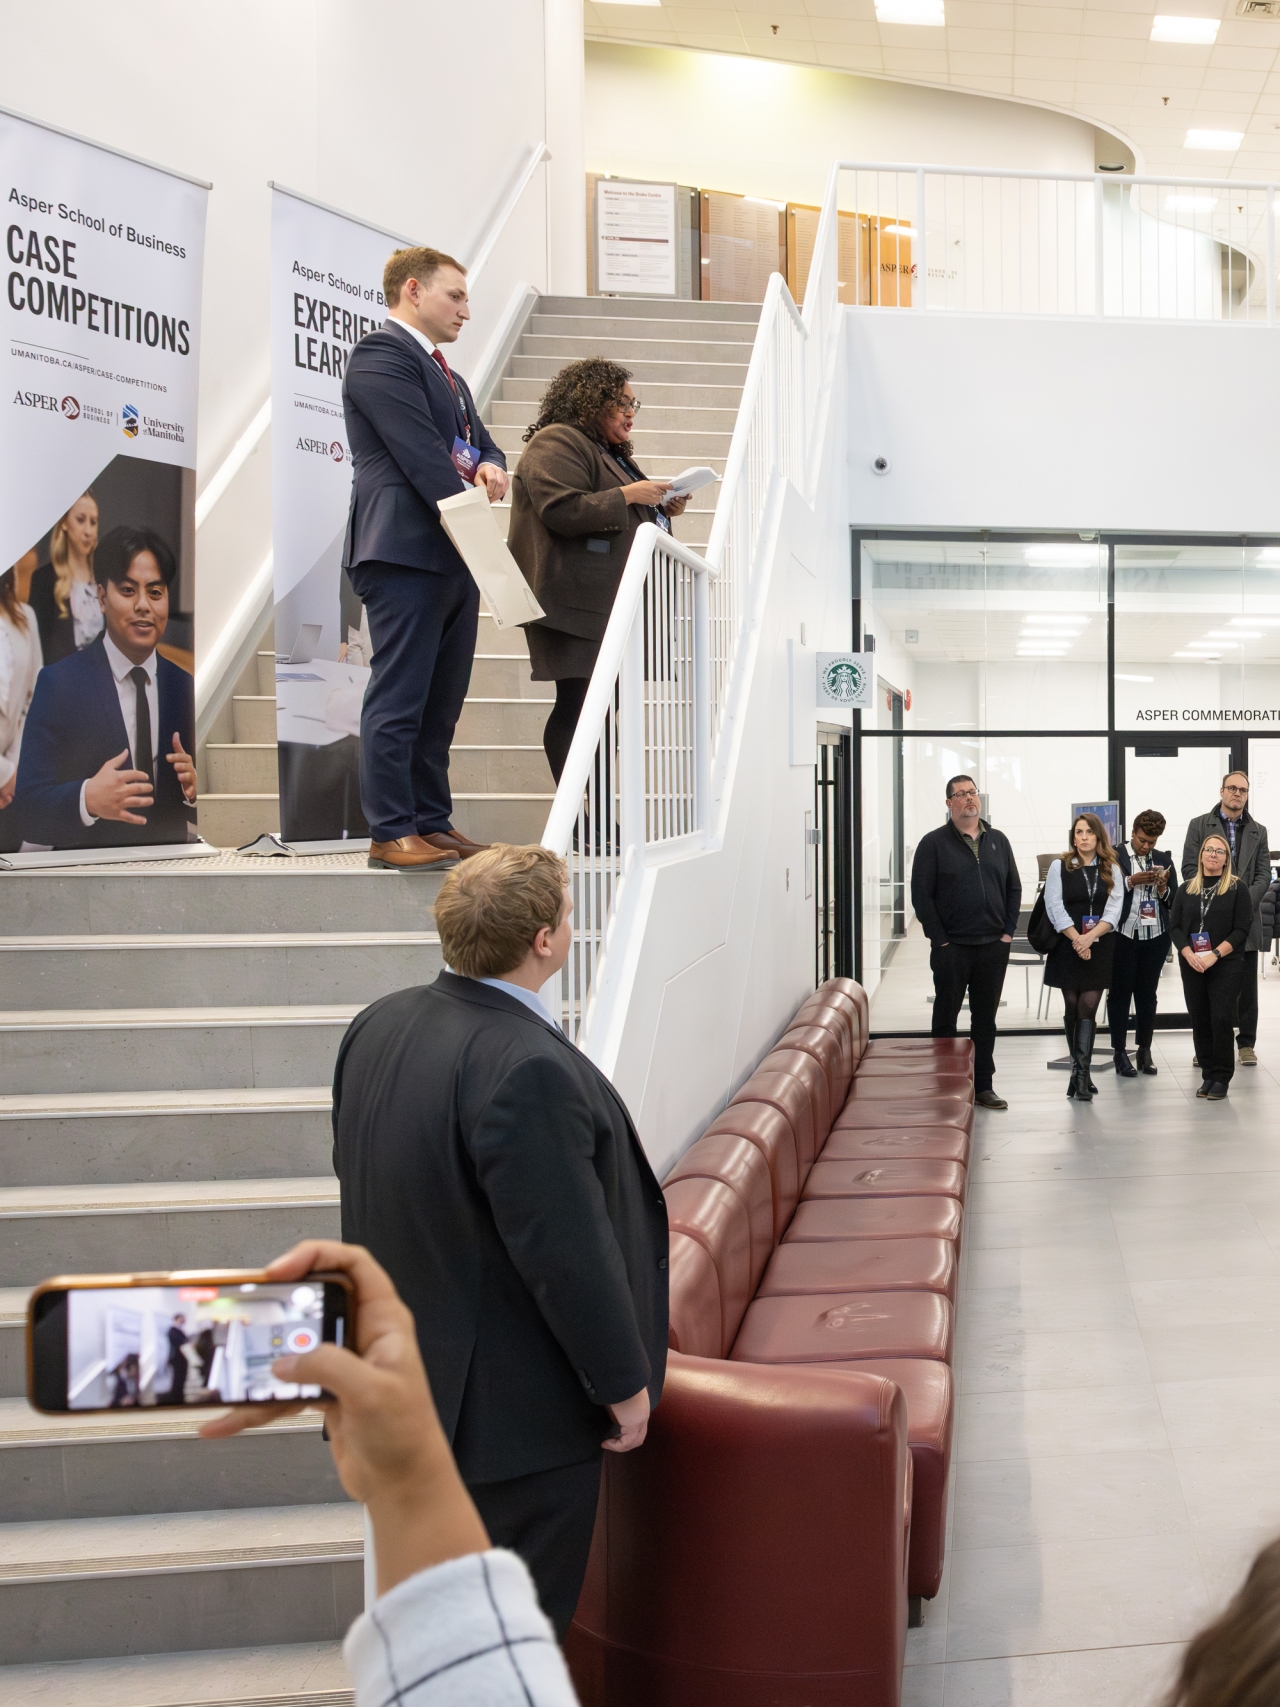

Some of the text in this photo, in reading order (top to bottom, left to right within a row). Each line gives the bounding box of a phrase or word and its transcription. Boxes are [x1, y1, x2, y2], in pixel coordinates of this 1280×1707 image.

[9, 187, 187, 260] Asper School of Business
[7, 223, 78, 280] CASE
[880, 263, 911, 275] ASPER
[292, 260, 326, 284] Asper
[328, 272, 361, 298] School
[364, 288, 375, 302] of
[7, 270, 191, 357] COMPETITIONS
[11, 347, 168, 393] UMANITOBA.CA/ASPER/CASE-COMPETITIONS
[13, 390, 59, 413] ASPER
[83, 404, 114, 418] SCHOOL OF
[83, 412, 111, 425] BUSINESS
[143, 416, 185, 434] University
[147, 427, 185, 444] Manitoba
[296, 436, 329, 457] ASPER
[828, 658, 852, 666] PROUDLY
[853, 661, 866, 674] SERVE
[1136, 709, 1179, 721] ASPER
